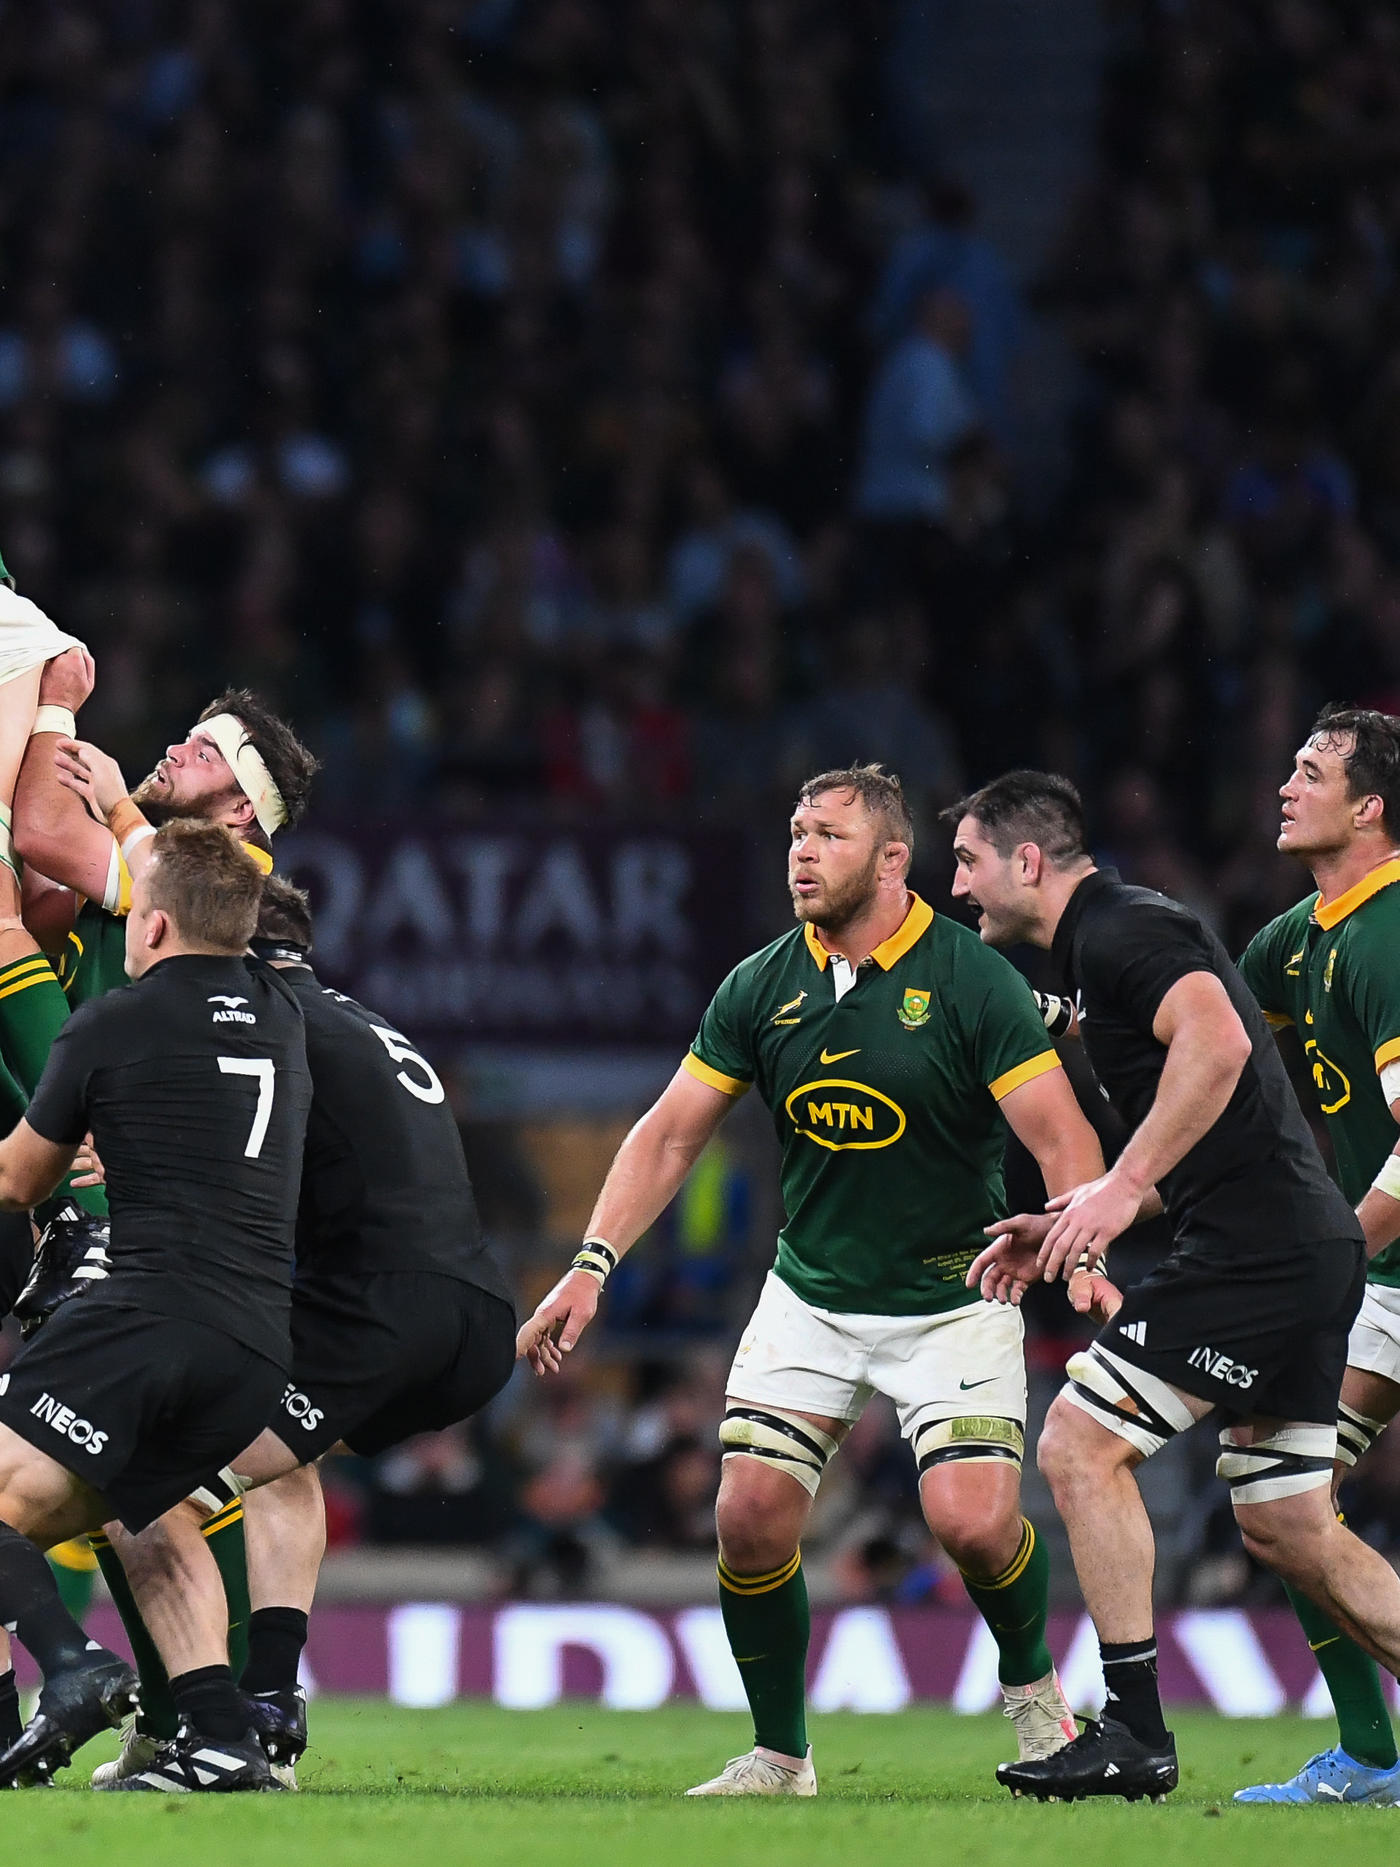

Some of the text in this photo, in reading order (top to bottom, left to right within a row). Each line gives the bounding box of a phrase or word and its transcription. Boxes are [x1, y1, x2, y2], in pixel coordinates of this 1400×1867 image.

[212, 1010, 256, 1024] ALTRAD
[369, 1023, 445, 1104] 5
[217, 1056, 275, 1158] 7
[807, 1102, 874, 1131] MTN
[1187, 1347, 1259, 1389] INEOS
[29, 1392, 109, 1455] INEOS
